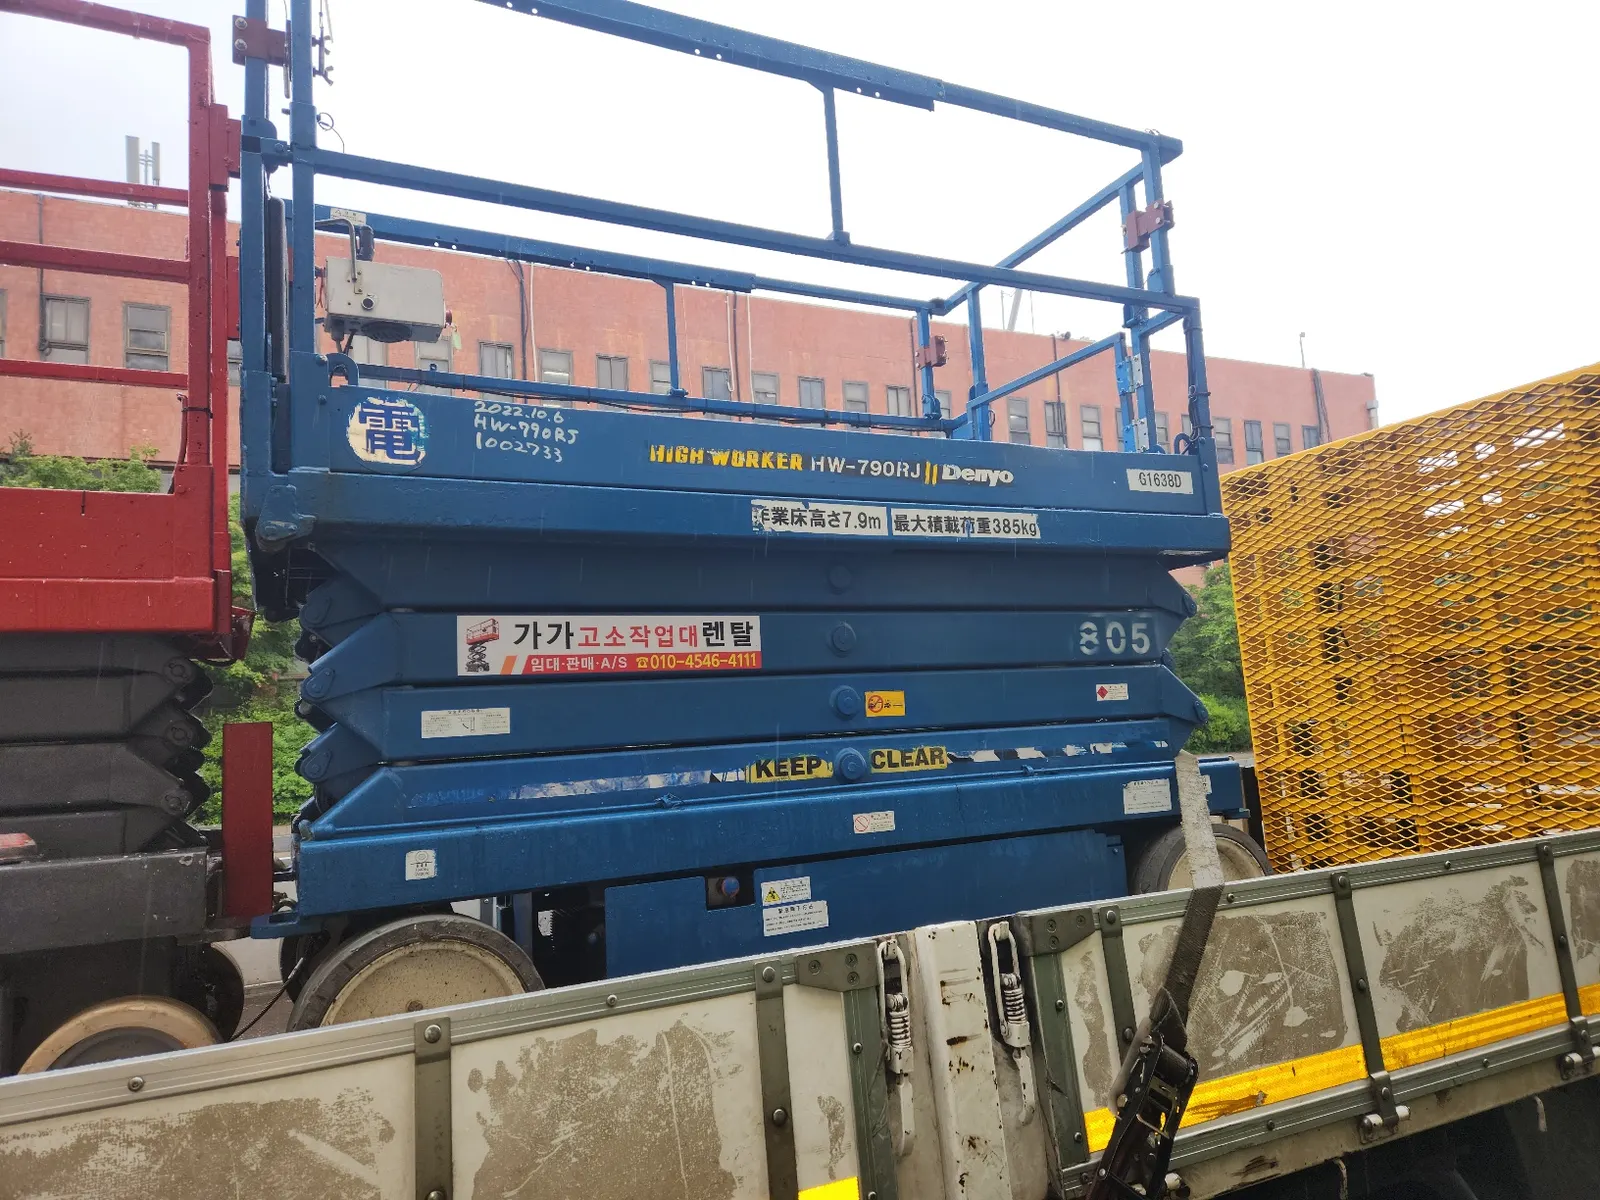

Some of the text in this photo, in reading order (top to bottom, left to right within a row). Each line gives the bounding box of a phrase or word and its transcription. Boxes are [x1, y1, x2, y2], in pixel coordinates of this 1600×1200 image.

[474, 400, 565, 424] 2022.10.6
[475, 432, 563, 463] 1002733
[649, 444, 1015, 487] HIGH WORKER HW-790RJ Denyo
[1138, 471, 1182, 488] G1638D
[1079, 620, 1151, 656] 805
[755, 747, 946, 779] KEEP CLEAR
